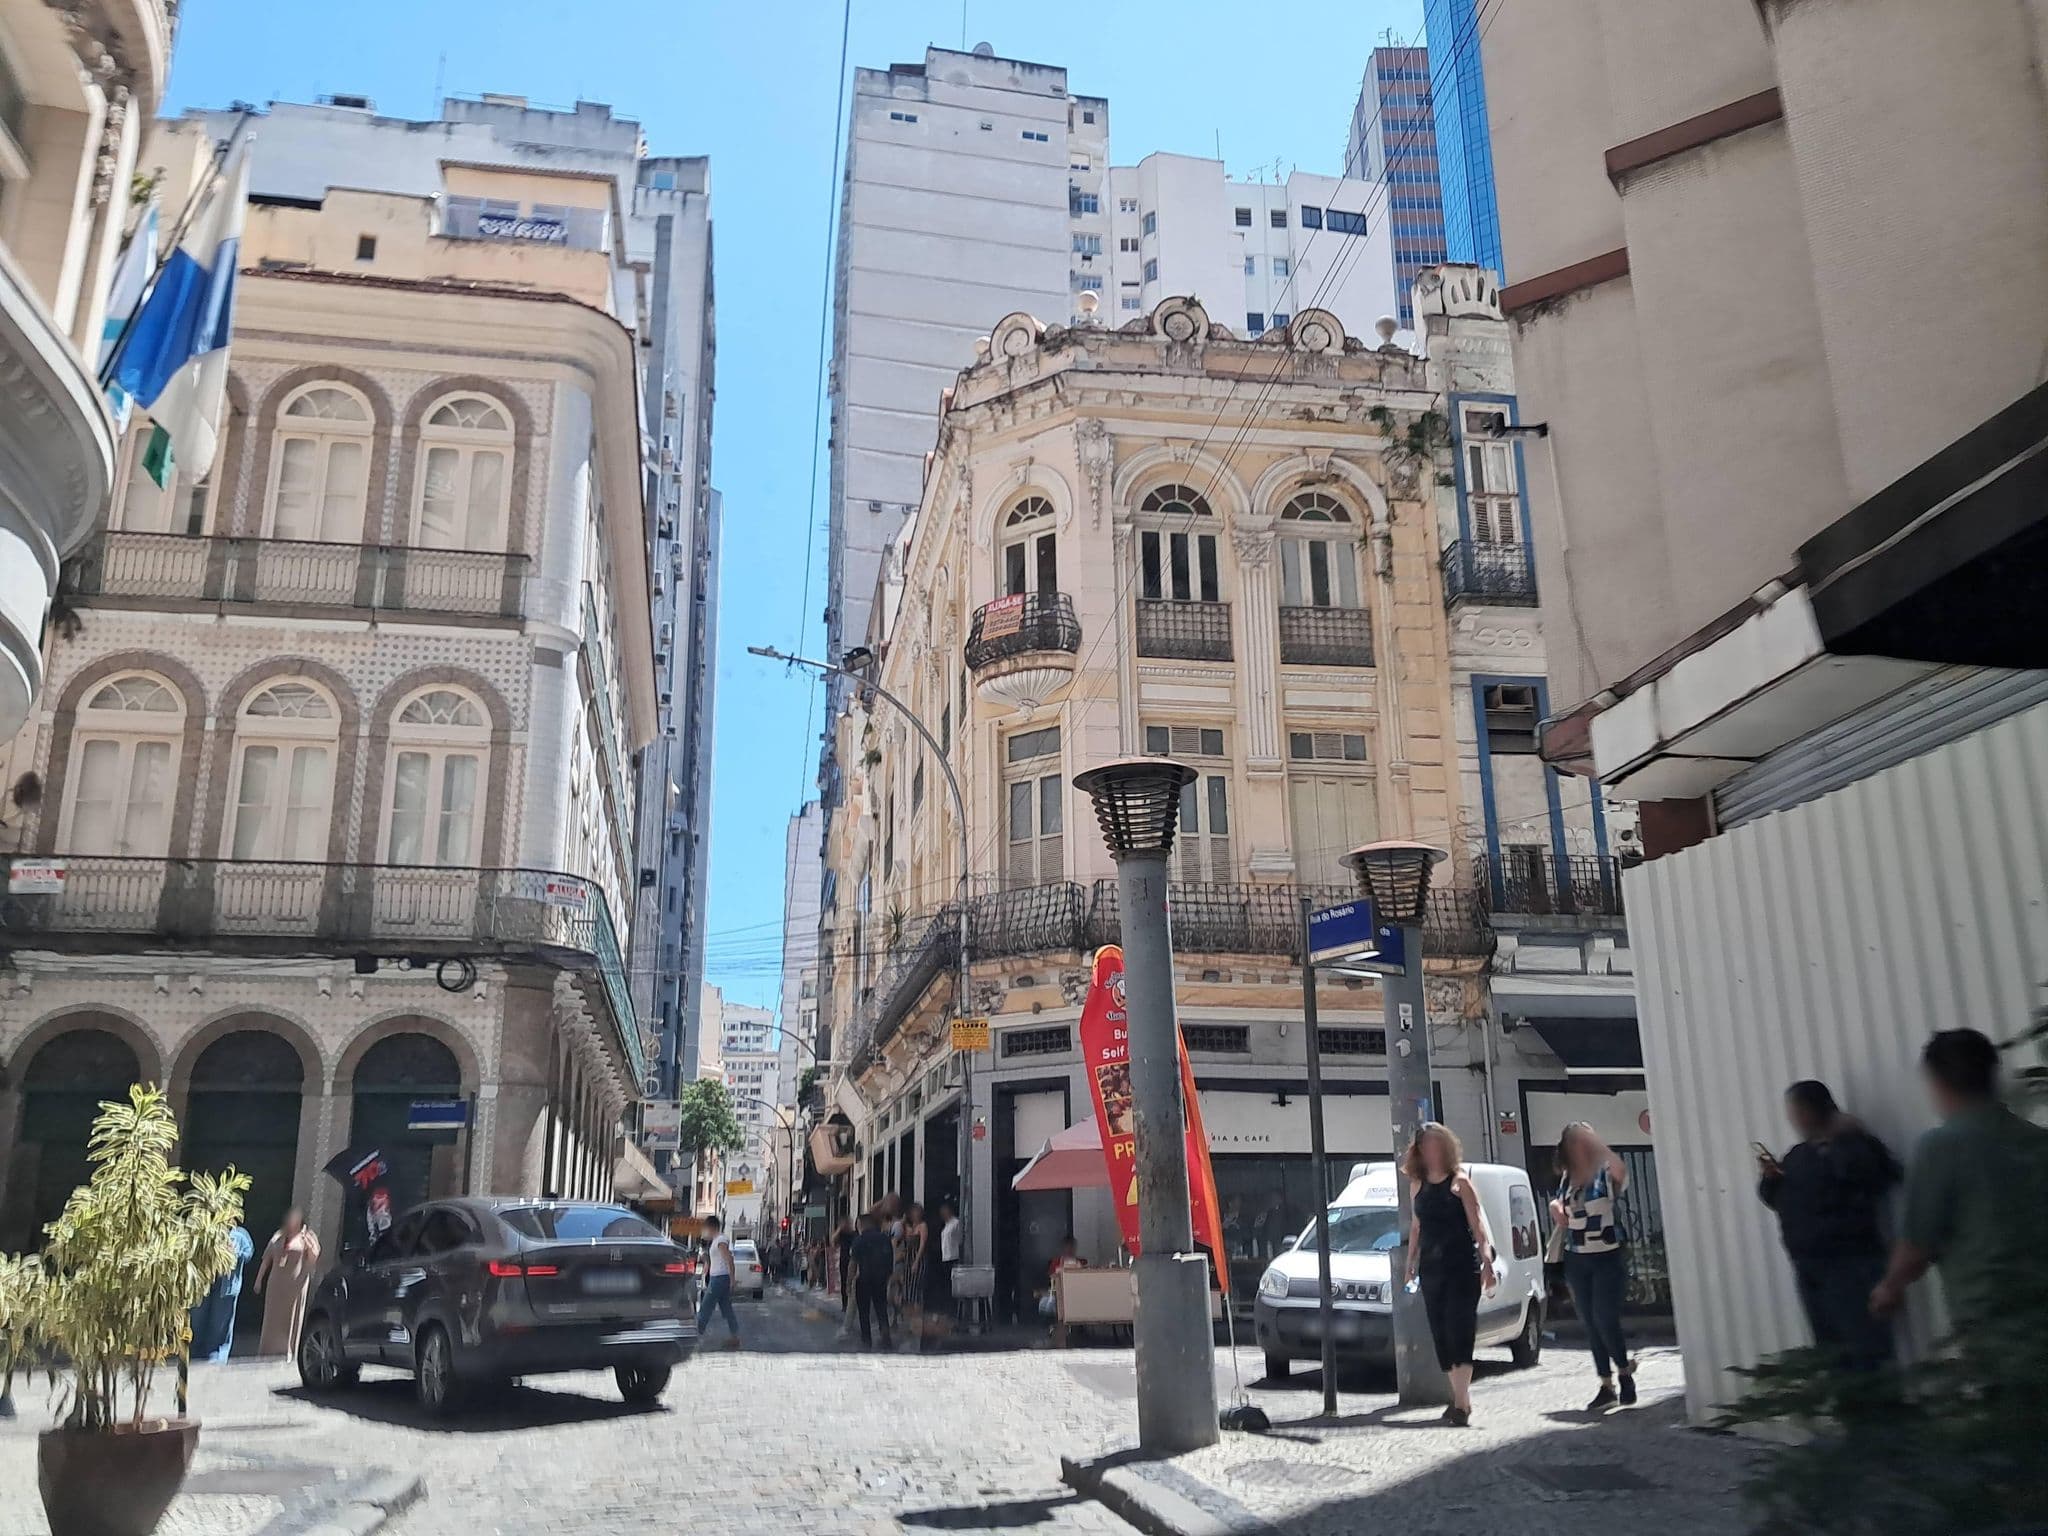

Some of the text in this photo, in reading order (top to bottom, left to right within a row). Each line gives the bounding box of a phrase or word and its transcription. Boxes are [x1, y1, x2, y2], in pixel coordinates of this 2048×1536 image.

[1321, 911, 1331, 922] do
[1330, 905, 1355, 919] Rosário
[1102, 1045, 1125, 1059] Self
